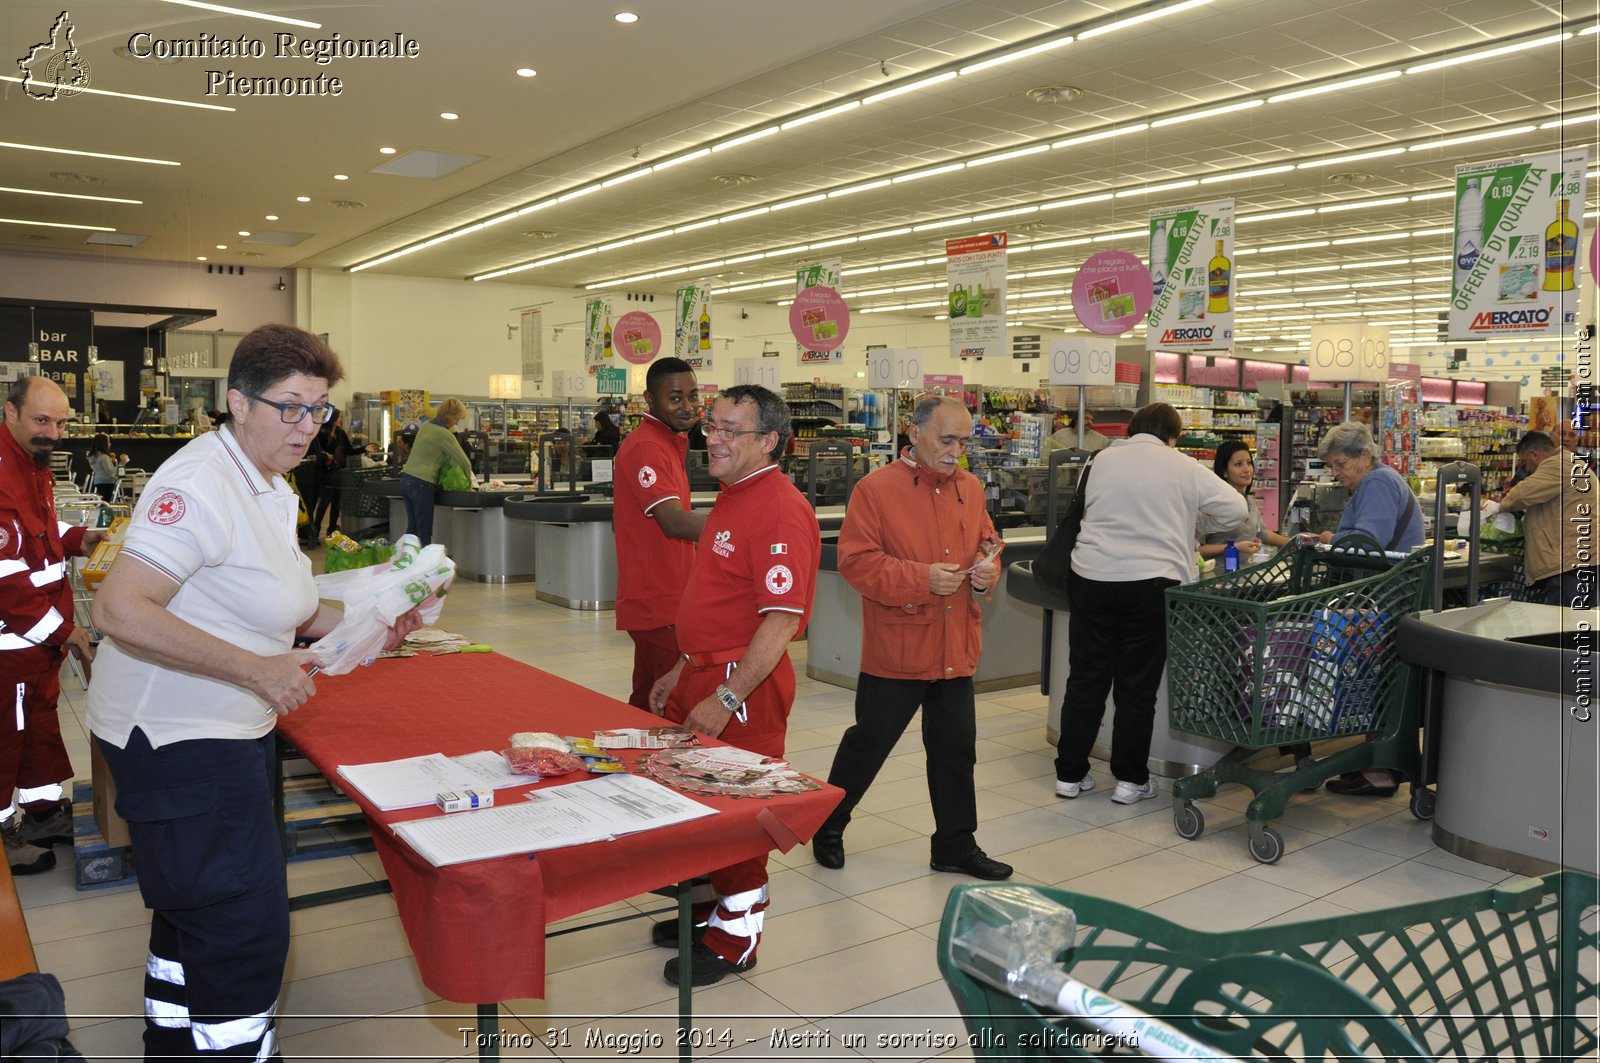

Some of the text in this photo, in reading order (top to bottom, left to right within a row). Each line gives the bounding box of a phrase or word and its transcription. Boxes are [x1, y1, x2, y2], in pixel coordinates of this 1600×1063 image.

[1454, 253, 1496, 311] OFFERTE
[1487, 234, 1507, 253] DI
[1149, 282, 1176, 328] OFFERTE
[1171, 266, 1183, 280] DI
[40, 330, 67, 342] bar
[40, 350, 78, 362] BAR
[1054, 350, 1111, 374] 09 09
[1316, 338, 1385, 369] 08 08
[758, 366, 775, 385] 11
[871, 358, 919, 380] 10 10
[568, 376, 584, 391] 13
[1144, 1025, 1189, 1054] plastica
